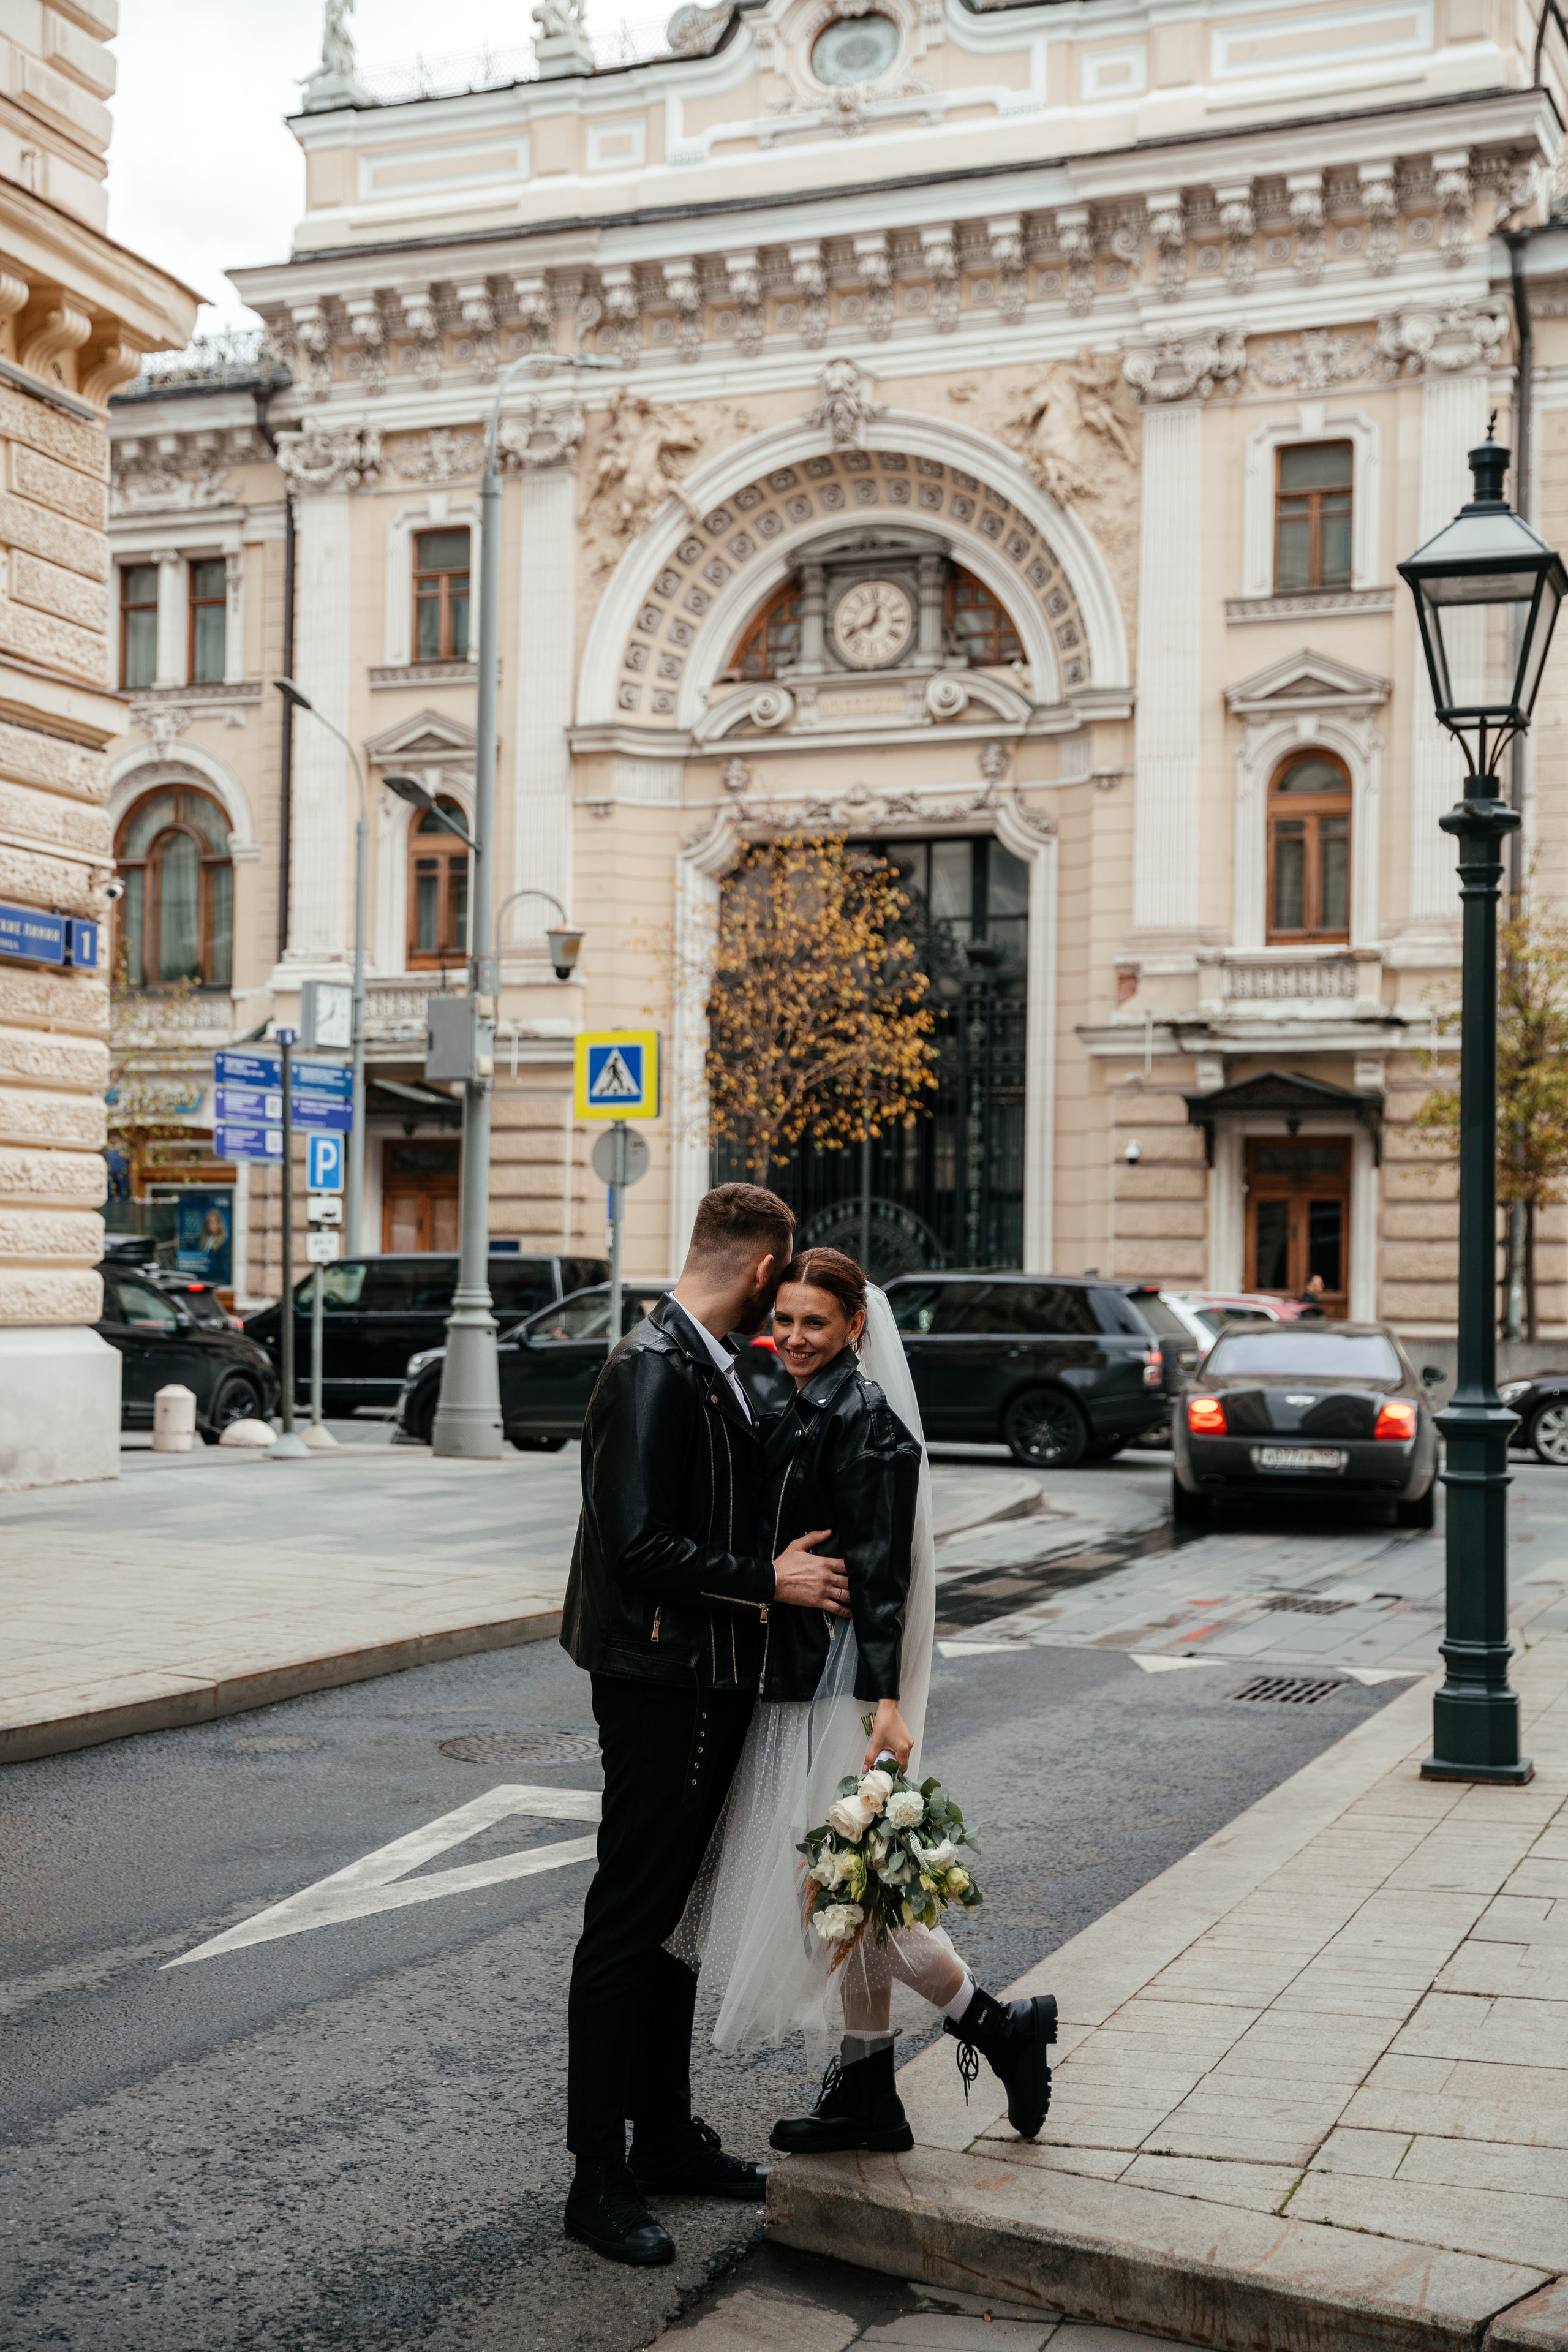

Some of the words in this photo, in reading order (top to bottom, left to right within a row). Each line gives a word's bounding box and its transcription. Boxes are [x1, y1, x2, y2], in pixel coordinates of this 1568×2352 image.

[81, 930, 91, 960] 1
[315, 1140, 338, 1186] P
[978, 2009, 987, 2024] Sports
